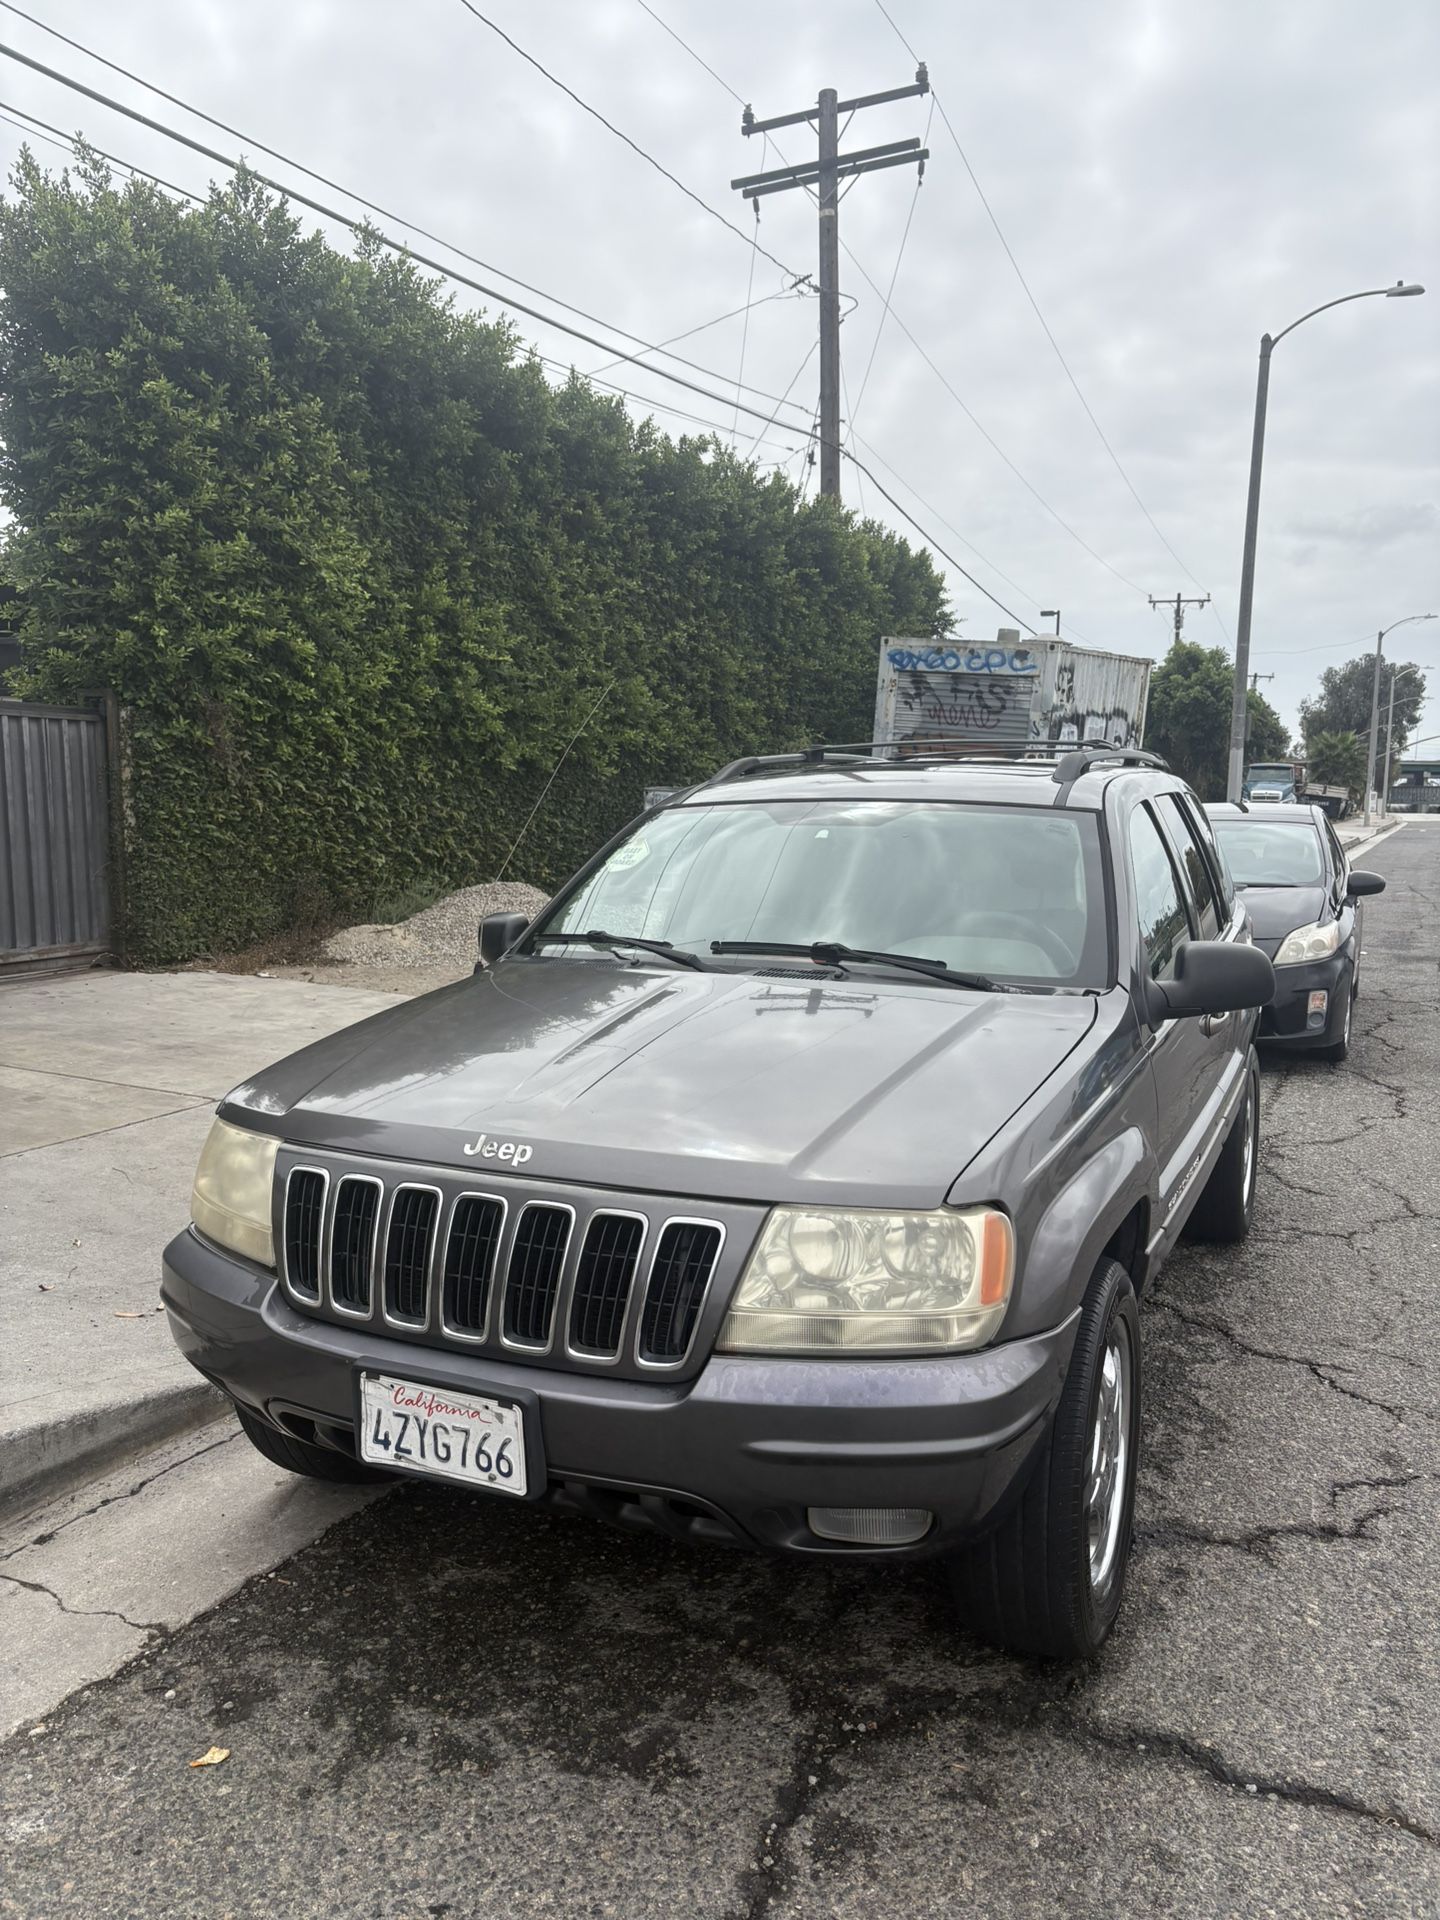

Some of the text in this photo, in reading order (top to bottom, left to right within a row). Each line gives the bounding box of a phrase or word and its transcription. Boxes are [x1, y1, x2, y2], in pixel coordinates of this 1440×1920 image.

[463, 1133, 534, 1168] Jeep
[393, 1386, 493, 1425] California
[372, 1407, 514, 1479] 4ZYG766
